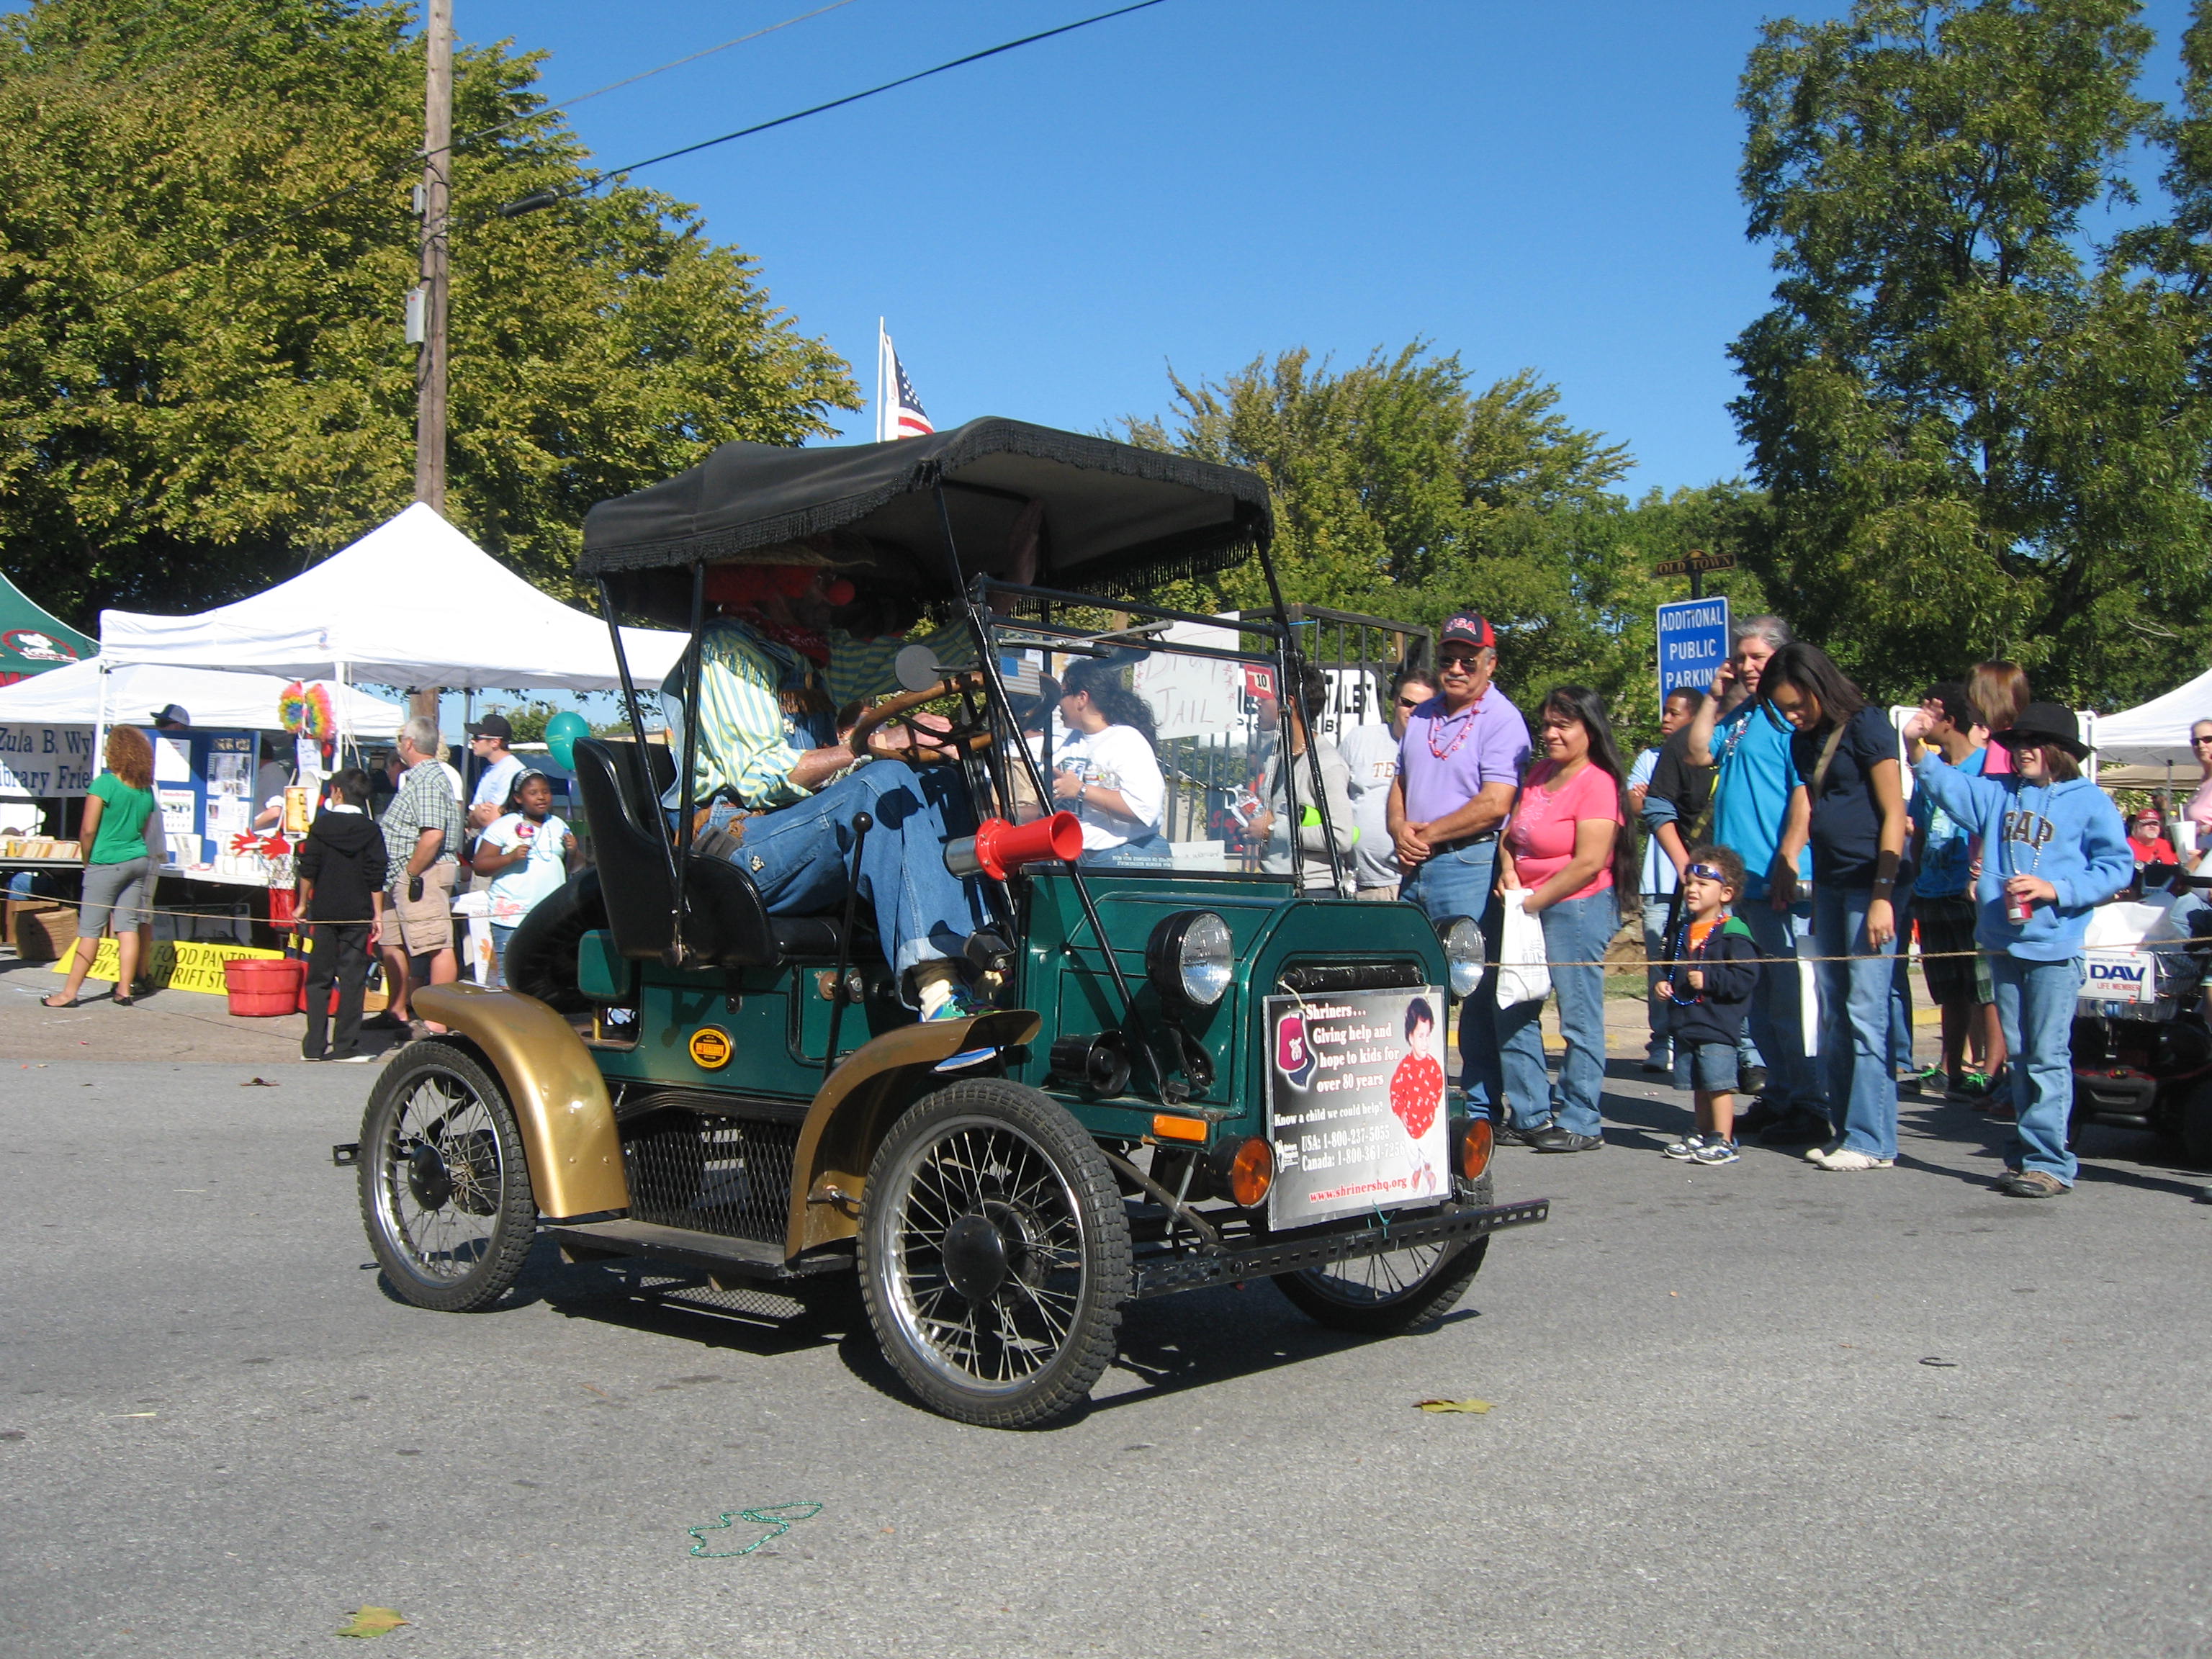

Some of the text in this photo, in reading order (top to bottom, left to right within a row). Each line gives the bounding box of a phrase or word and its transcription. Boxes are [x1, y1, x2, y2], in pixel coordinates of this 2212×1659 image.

[1659, 556, 1731, 575] OLD TOWN
[1661, 606, 1724, 631] ADDITIONAL
[1669, 639, 1717, 660] PUBLIC
[1256, 673, 1267, 688] 10
[1155, 686, 1215, 727] JAIL
[2002, 810, 2055, 850] GAP
[2090, 964, 2146, 981] DAV
[1313, 1022, 1392, 1046] Giving help and
[1319, 1046, 1400, 1071] hope to kids for
[1316, 1073, 1384, 1092] over 80 years
[1274, 1113, 1297, 1127] Know
[1305, 1108, 1326, 1123] child
[1327, 1110, 1338, 1119] we
[1339, 1105, 1361, 1118] could
[1362, 1101, 1383, 1117] help?
[1301, 1124, 1390, 1153] USA: 1-800-237-5055
[1302, 1154, 1335, 1172] Canada:
[1309, 1177, 1407, 1203] www.shrinershq.org
